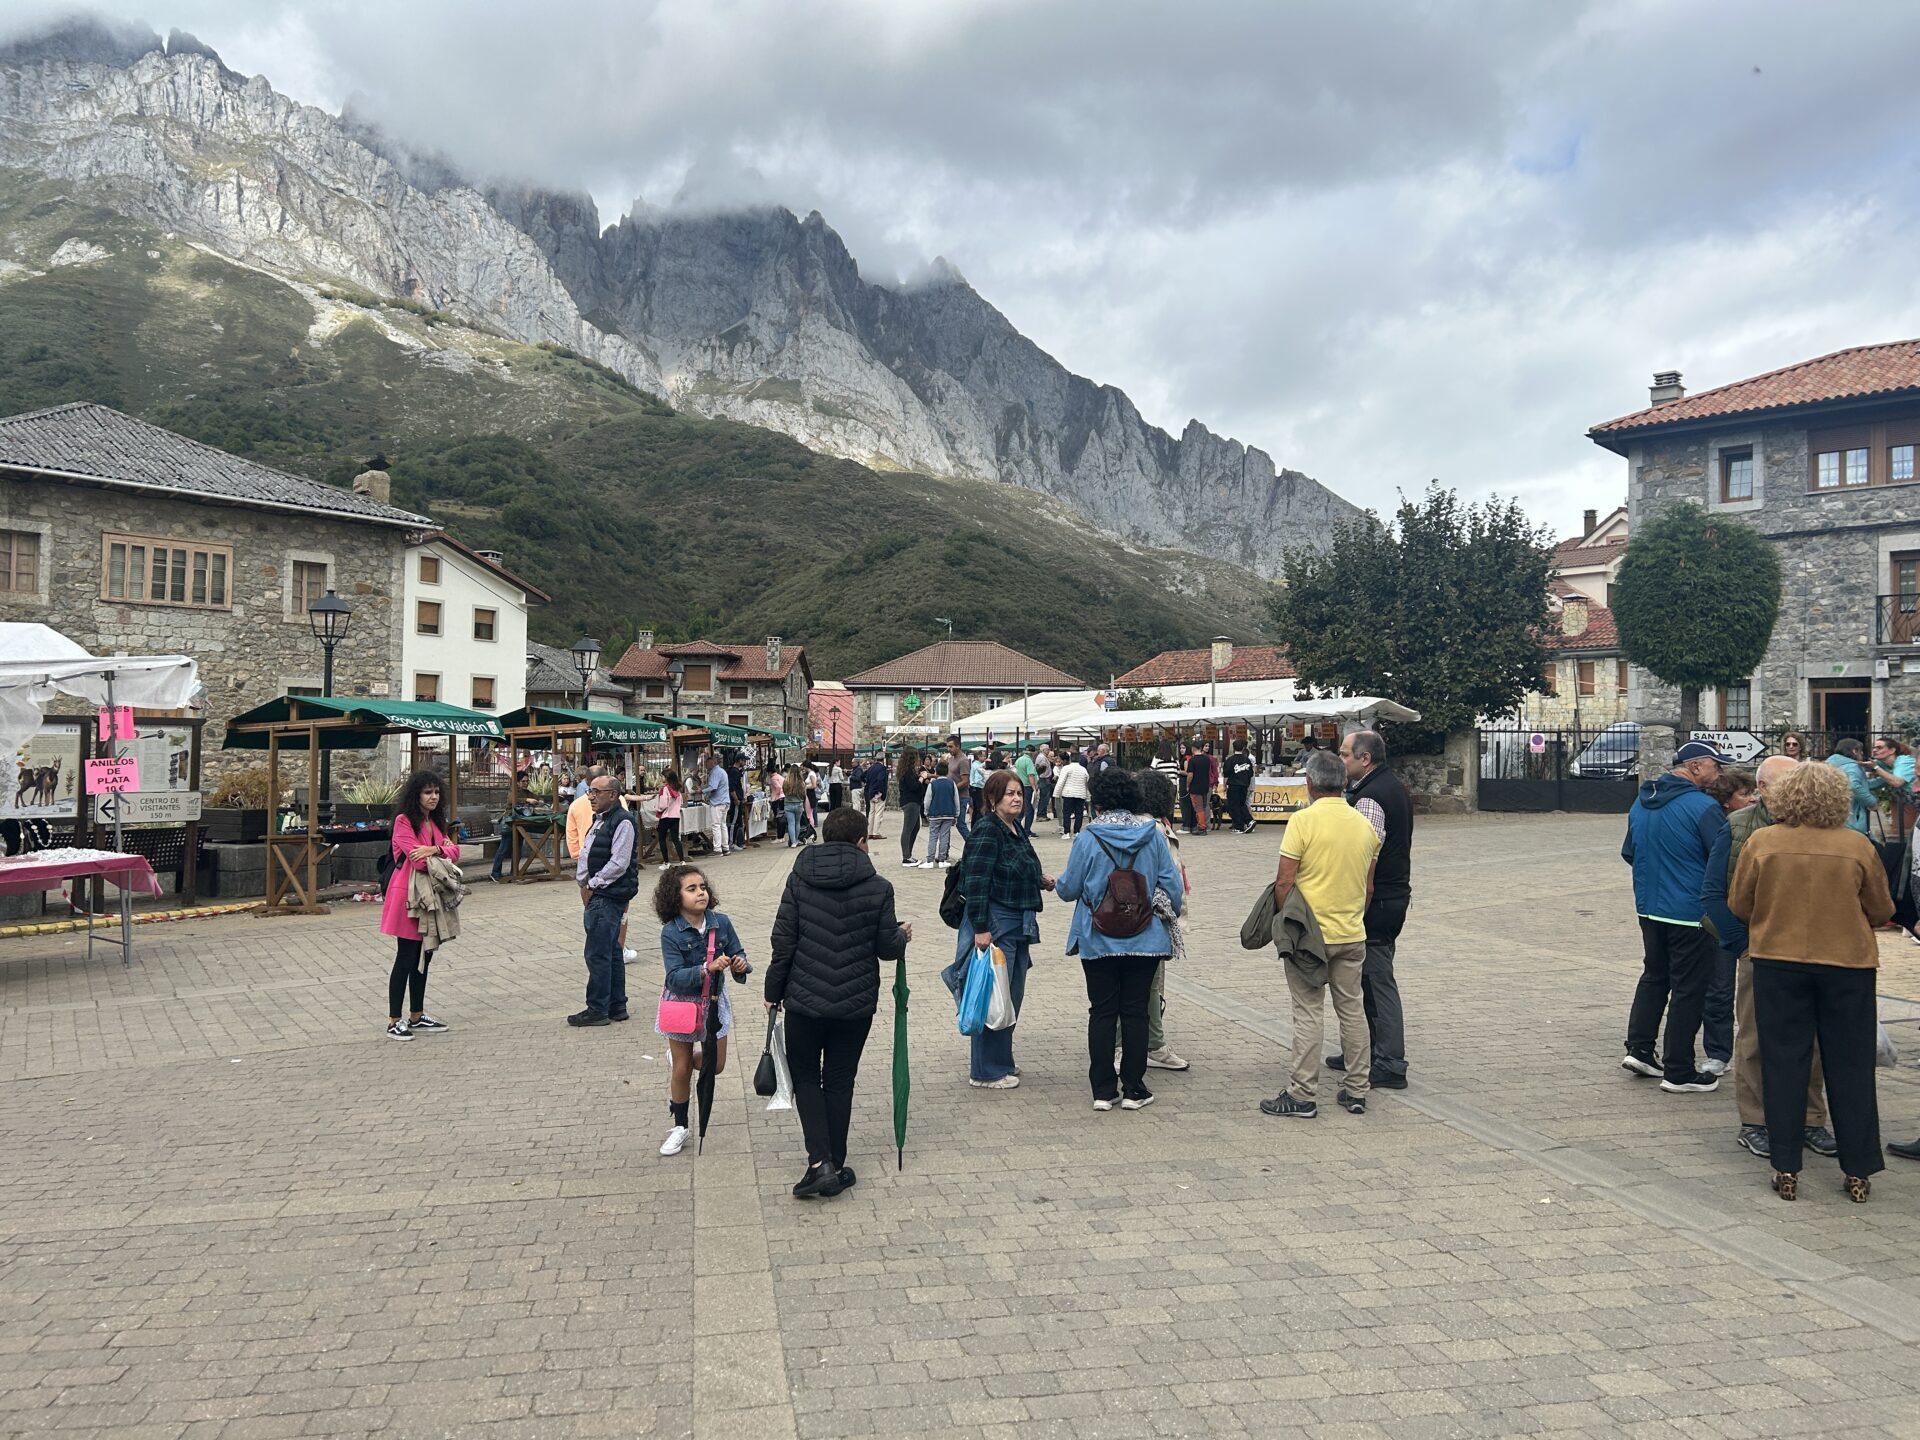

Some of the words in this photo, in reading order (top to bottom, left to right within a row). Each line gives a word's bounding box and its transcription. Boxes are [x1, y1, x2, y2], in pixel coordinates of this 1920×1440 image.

[433, 719, 447, 730] de
[444, 720, 488, 733] Valdeón
[90, 758, 134, 767] ANILLOS
[97, 776, 130, 785] PLATA
[1253, 791, 1290, 804] DERA
